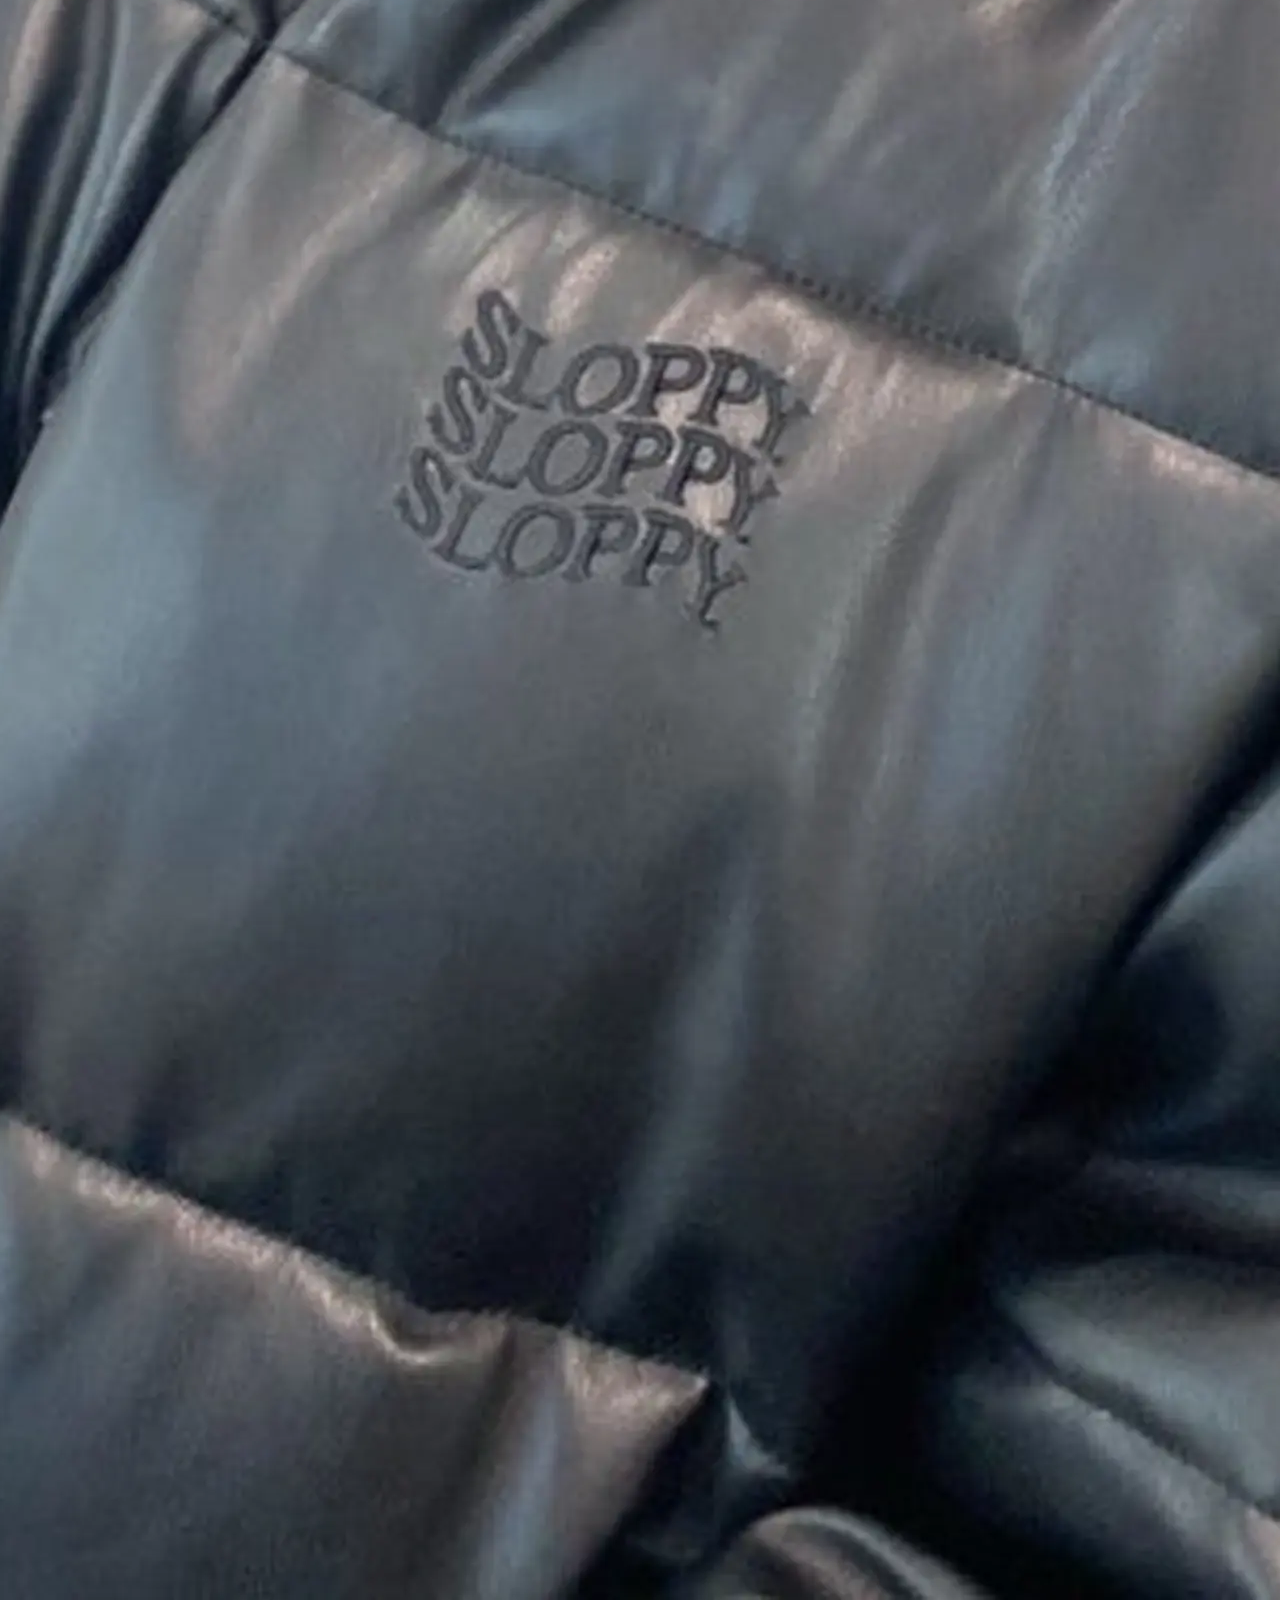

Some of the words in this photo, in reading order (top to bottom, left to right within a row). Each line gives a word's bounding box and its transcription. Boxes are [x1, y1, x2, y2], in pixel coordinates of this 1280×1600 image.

[426, 365, 781, 546] SLOPPY
[461, 288, 816, 467] SLOPPY
[393, 446, 748, 631] SLOPPY
